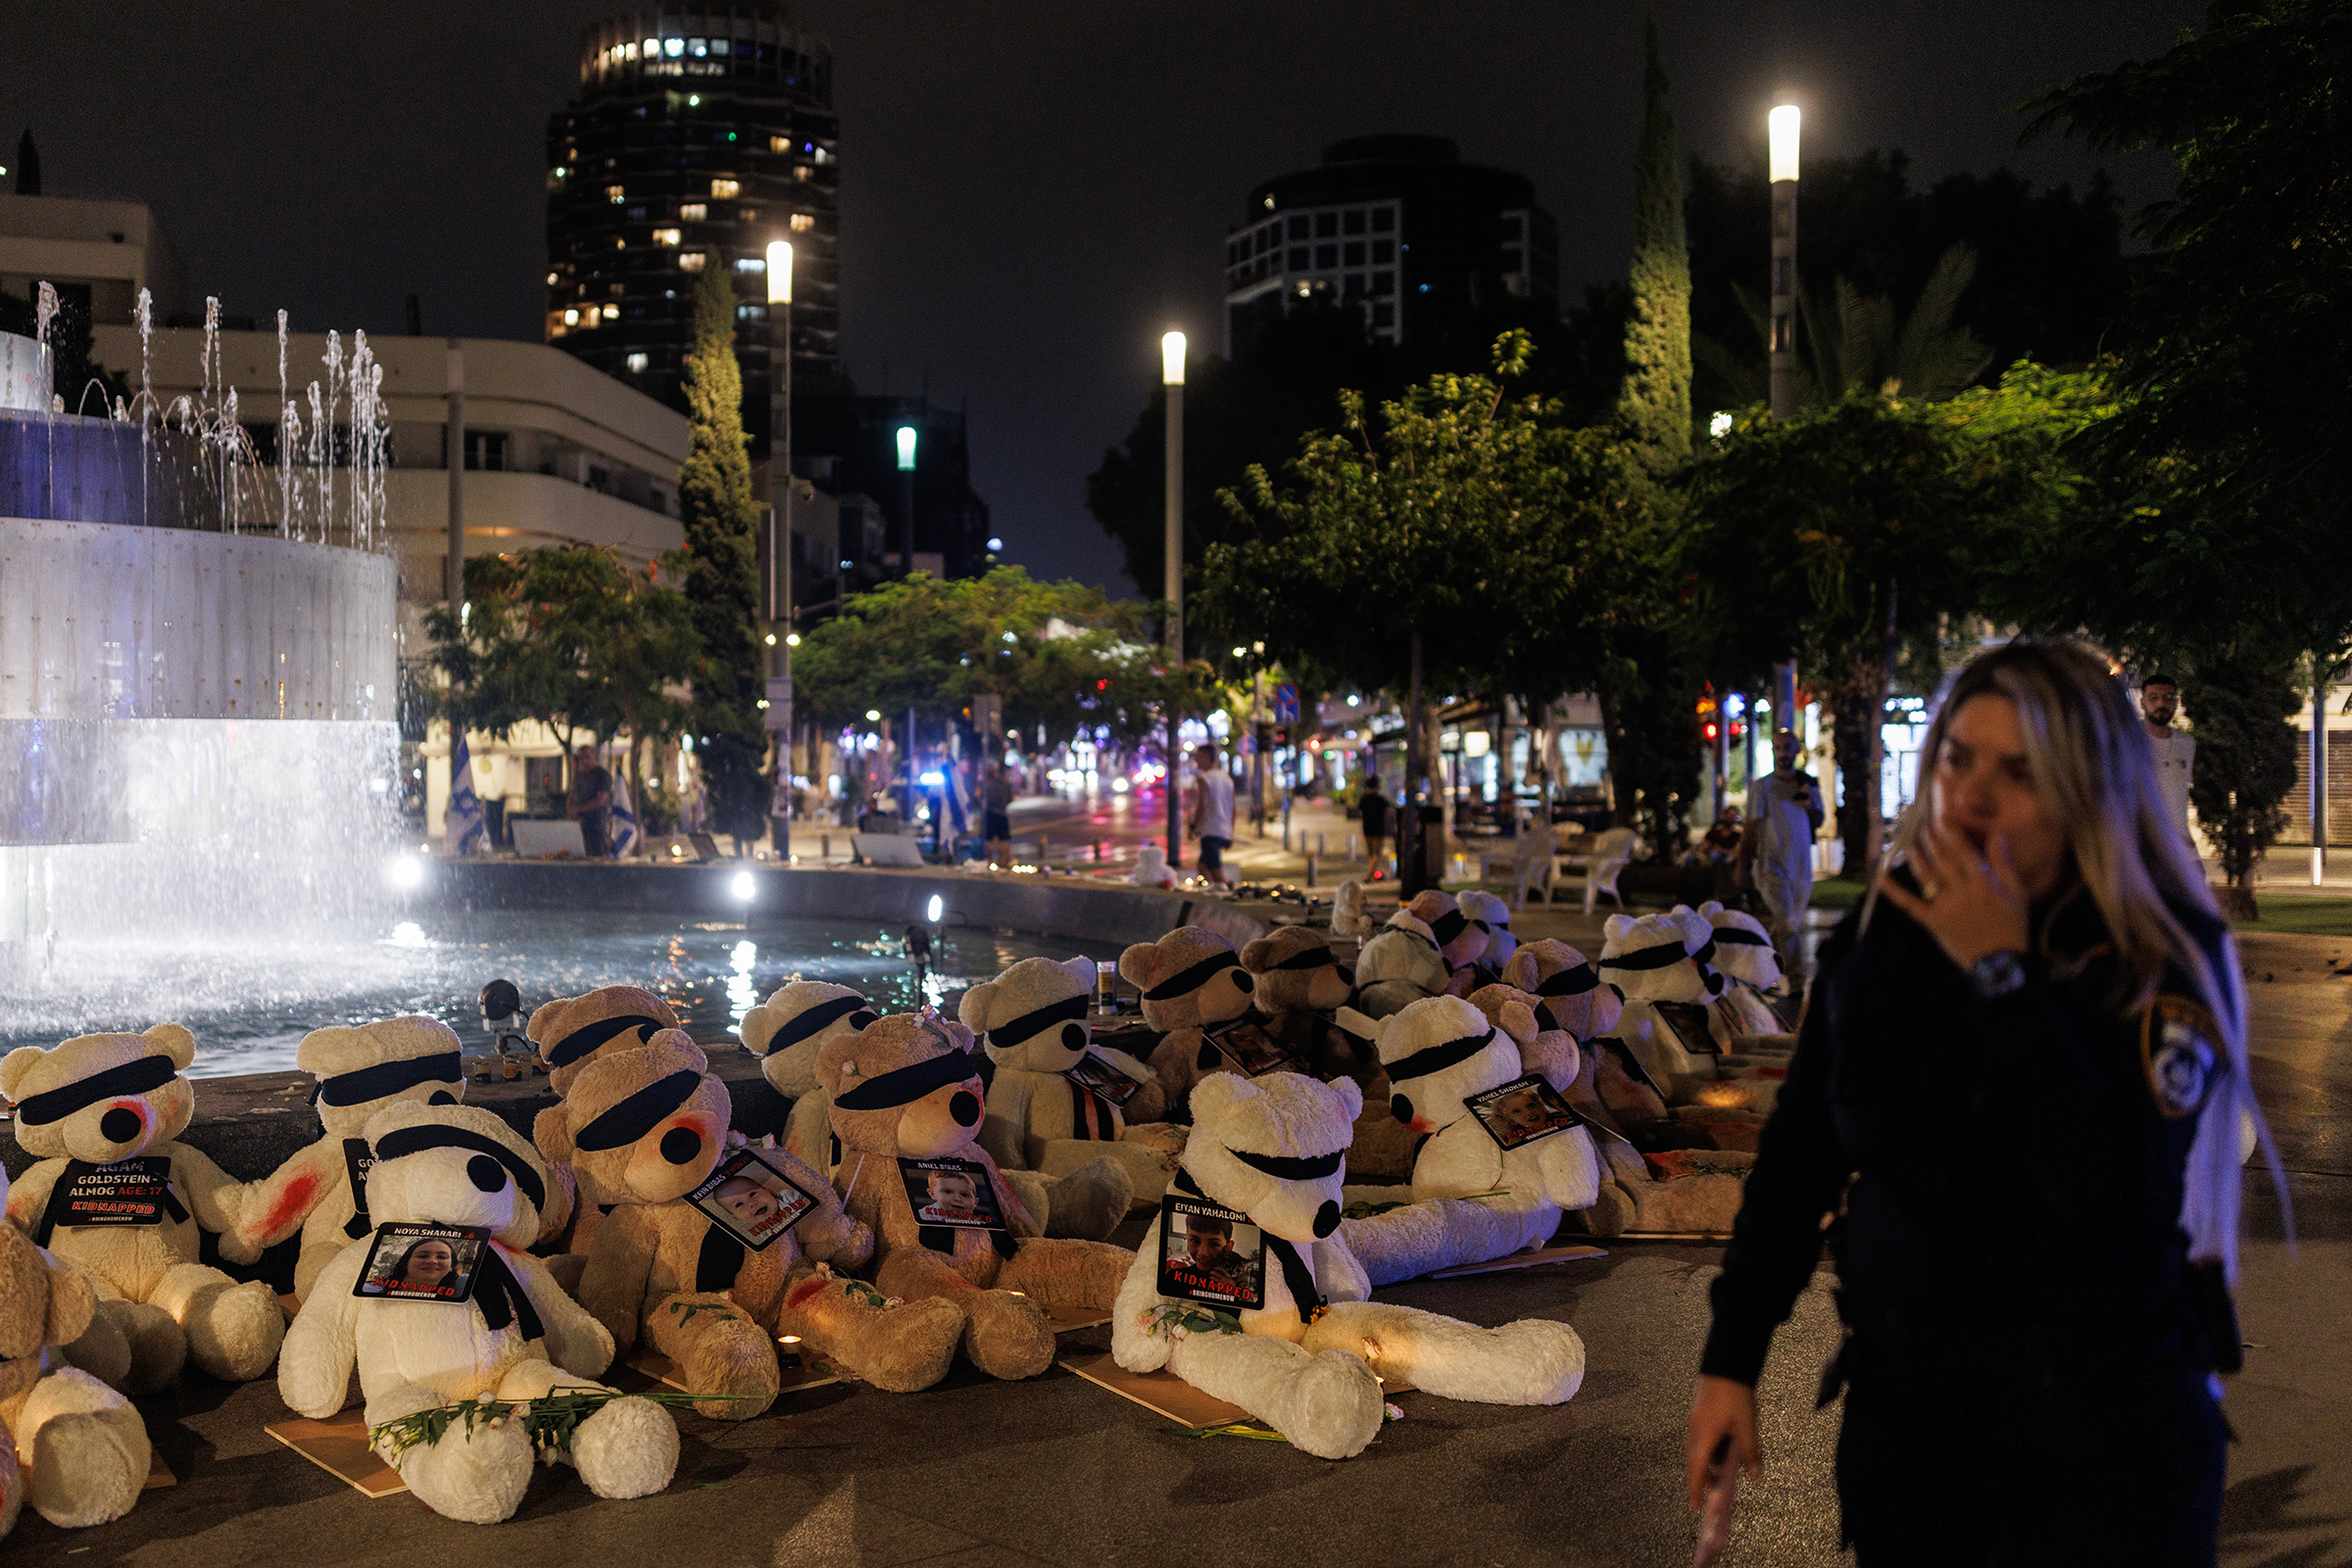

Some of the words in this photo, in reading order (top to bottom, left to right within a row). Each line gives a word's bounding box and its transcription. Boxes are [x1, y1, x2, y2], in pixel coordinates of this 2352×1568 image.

[1505, 1117, 1568, 1139] KIDNAPPED
[95, 1161, 144, 1172] AGAM
[69, 1187, 116, 1197] ALMOG
[118, 1186, 146, 1196] AGE:
[149, 1186, 164, 1196] 17
[692, 1186, 710, 1200] KFIR
[706, 1173, 726, 1190] BIBAS
[72, 1200, 156, 1215] KIDNAPPED
[926, 1207, 993, 1223] KIDNAPPED
[1200, 1206, 1247, 1222] YAHALOMI
[749, 1199, 806, 1237] KIDNAPPED
[394, 1227, 419, 1236] NOYA
[420, 1229, 462, 1238] SHARABI
[373, 1278, 456, 1297] KIDNAPPED
[1173, 1270, 1250, 1299] KIDNAPPED
